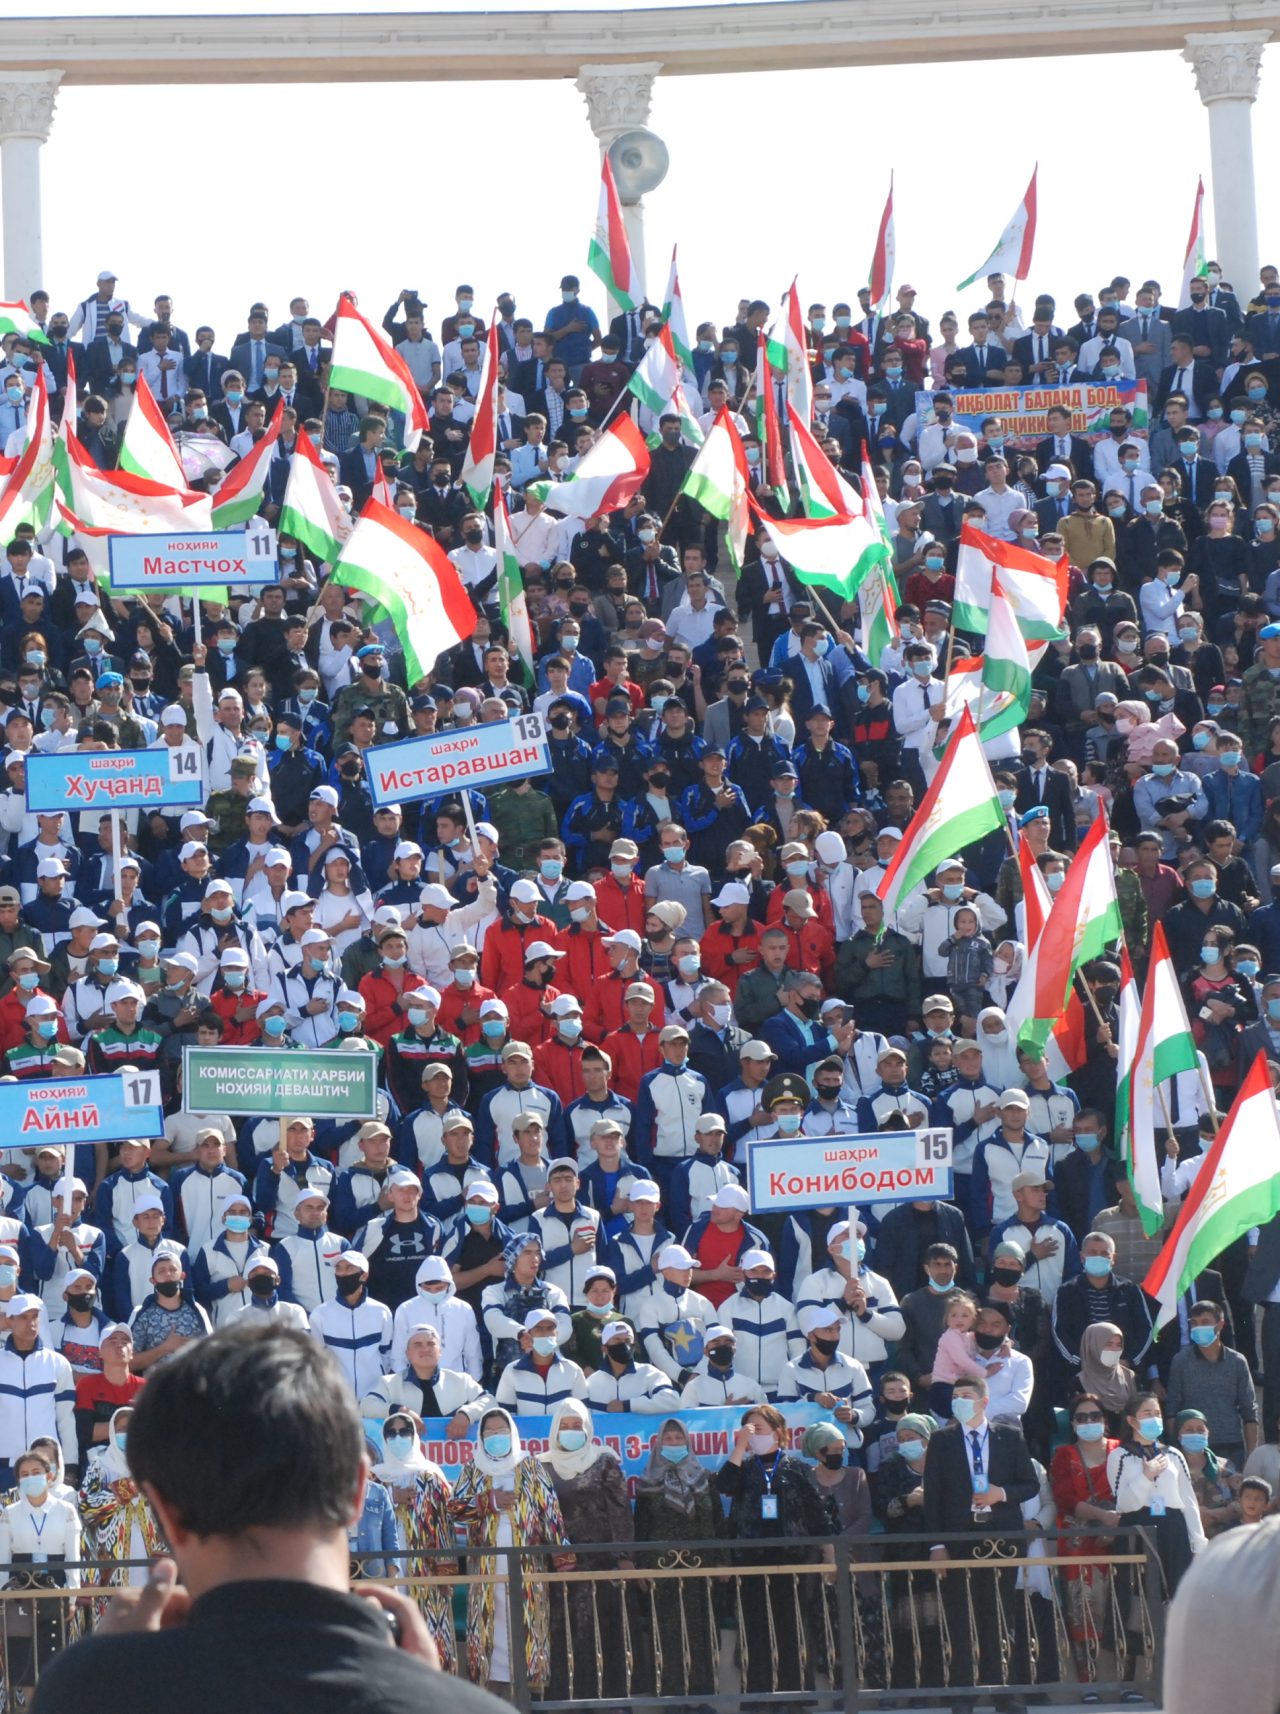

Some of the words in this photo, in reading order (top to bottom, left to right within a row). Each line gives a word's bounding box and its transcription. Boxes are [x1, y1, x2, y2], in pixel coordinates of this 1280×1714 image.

[1024, 389, 1082, 410] БАЛАНД
[168, 541, 218, 552] ноҳияи
[251, 534, 271, 556] 11
[143, 556, 246, 575] Мастчоҳ
[514, 715, 541, 740] 13
[431, 737, 479, 756] шаҳри
[91, 758, 134, 769] шаҳри
[173, 752, 198, 775] 14
[380, 746, 538, 792] Истаравшан
[67, 776, 161, 801] Хуҷанд
[199, 1066, 309, 1081] КОМИССАРИАТИ
[311, 1069, 365, 1083] ҲАРБИИ
[29, 1087, 86, 1100] ноҳияи
[127, 1078, 152, 1105] 17
[216, 1083, 271, 1096] НОҲИЯИ
[275, 1084, 350, 1097] ДЕВАШТИЧ
[23, 1105, 99, 1132] Айнӣ
[825, 1148, 879, 1162] шаҳри
[919, 1133, 948, 1161] 15
[769, 1167, 935, 1196] Конибодом
